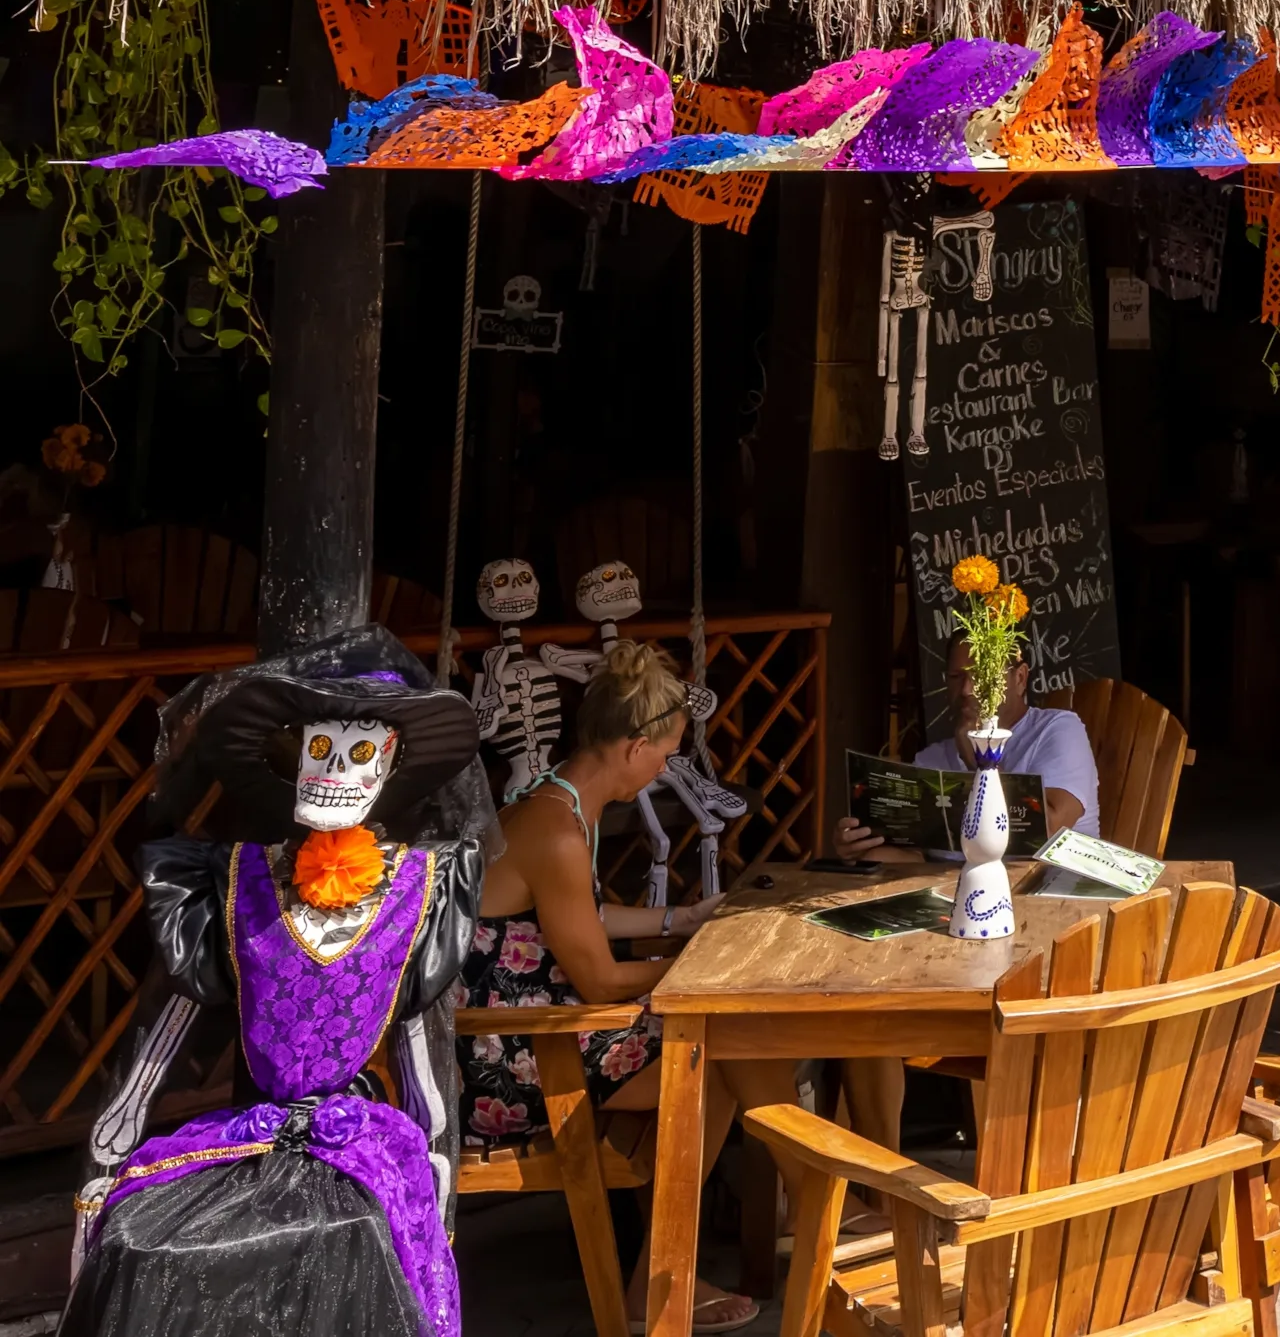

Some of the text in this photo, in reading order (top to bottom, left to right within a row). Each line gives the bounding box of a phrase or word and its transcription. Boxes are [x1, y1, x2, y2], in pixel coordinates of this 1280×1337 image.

[938, 229, 1063, 287] Stngray
[935, 304, 1053, 345] Mariscos
[978, 337, 1001, 362] &
[958, 360, 1047, 392] Carnes
[926, 383, 1036, 425] estaurant
[908, 443, 1105, 512] Eventos Especiales
[934, 503, 1083, 567] Micheladas
